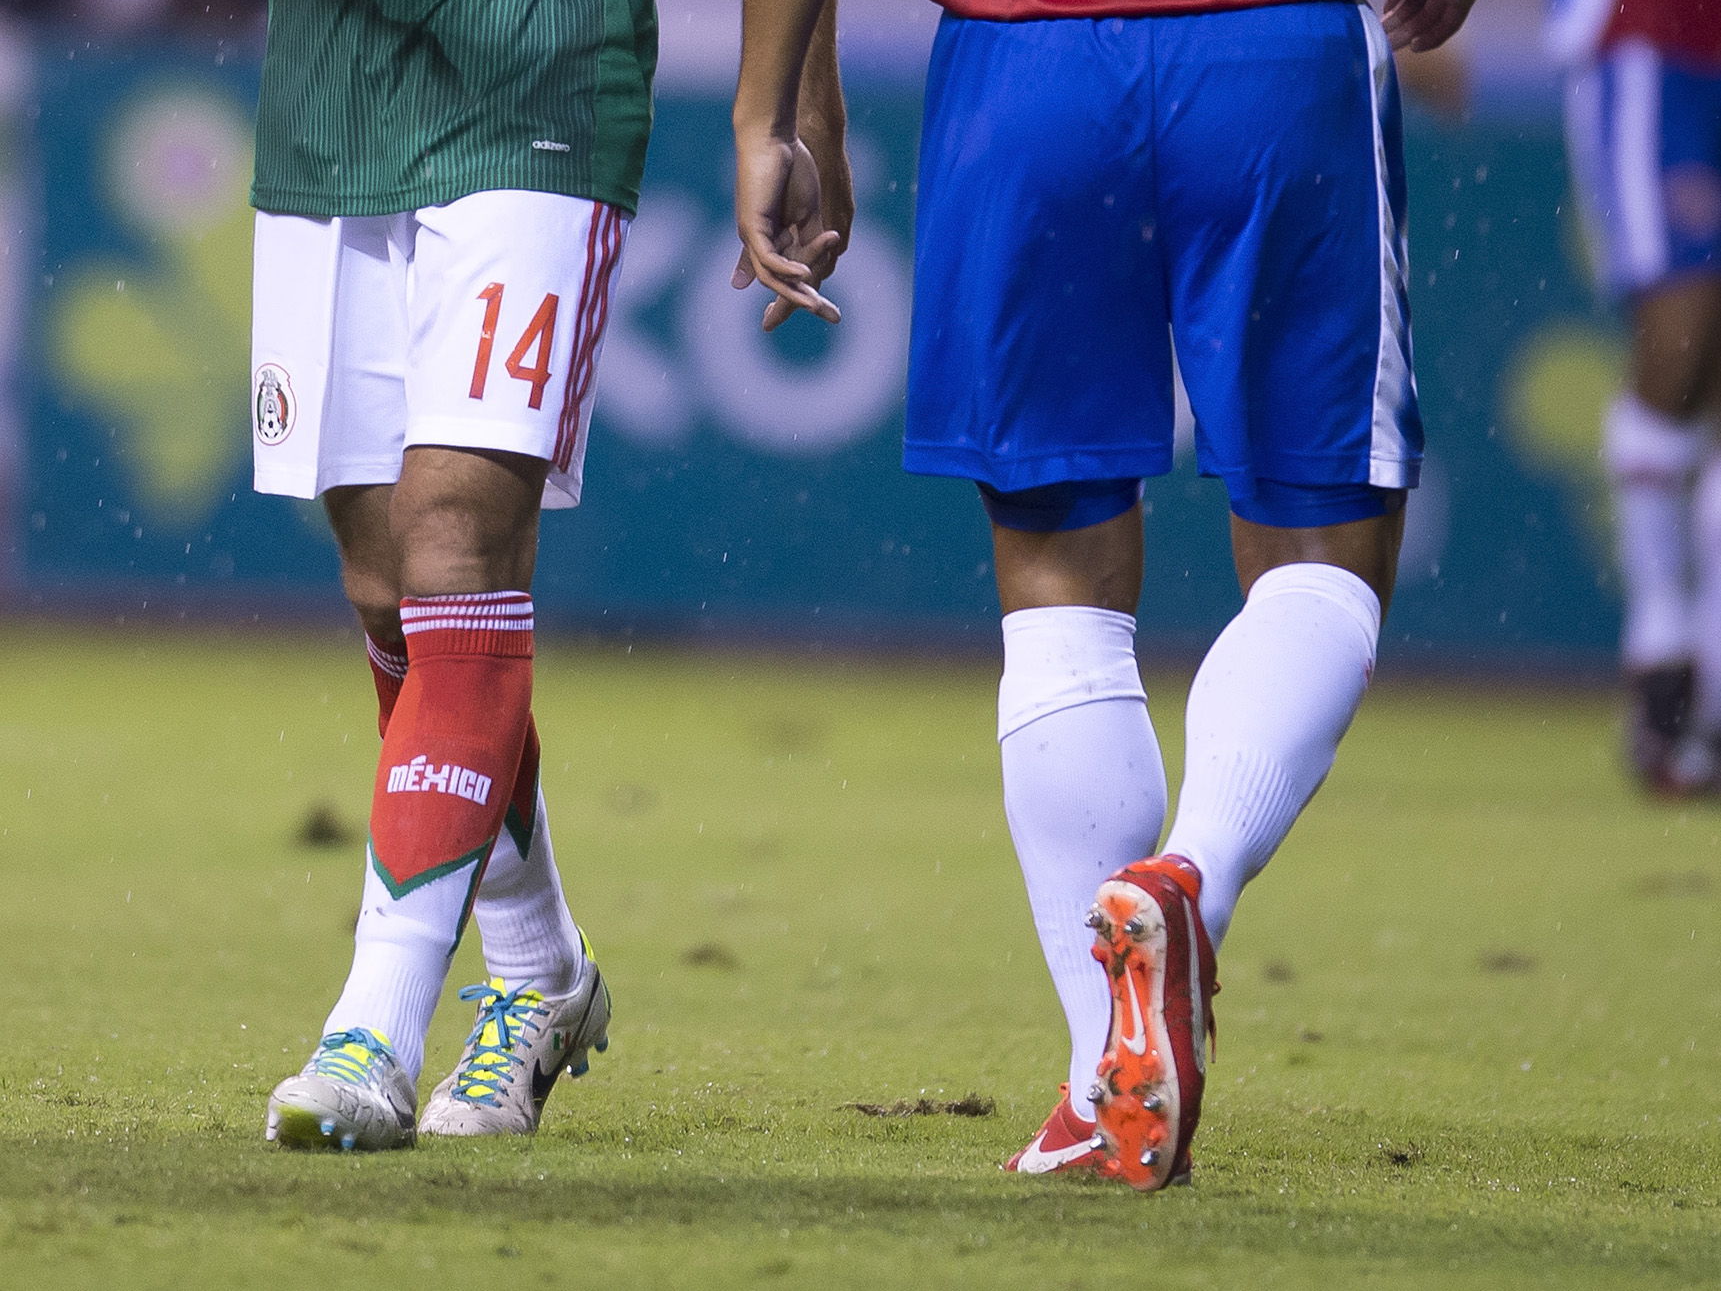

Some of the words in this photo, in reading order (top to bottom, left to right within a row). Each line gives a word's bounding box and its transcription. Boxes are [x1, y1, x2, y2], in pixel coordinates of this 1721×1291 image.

[532, 140, 571, 152] adizero
[468, 281, 560, 411] 14
[386, 754, 493, 807] MÉXICO
